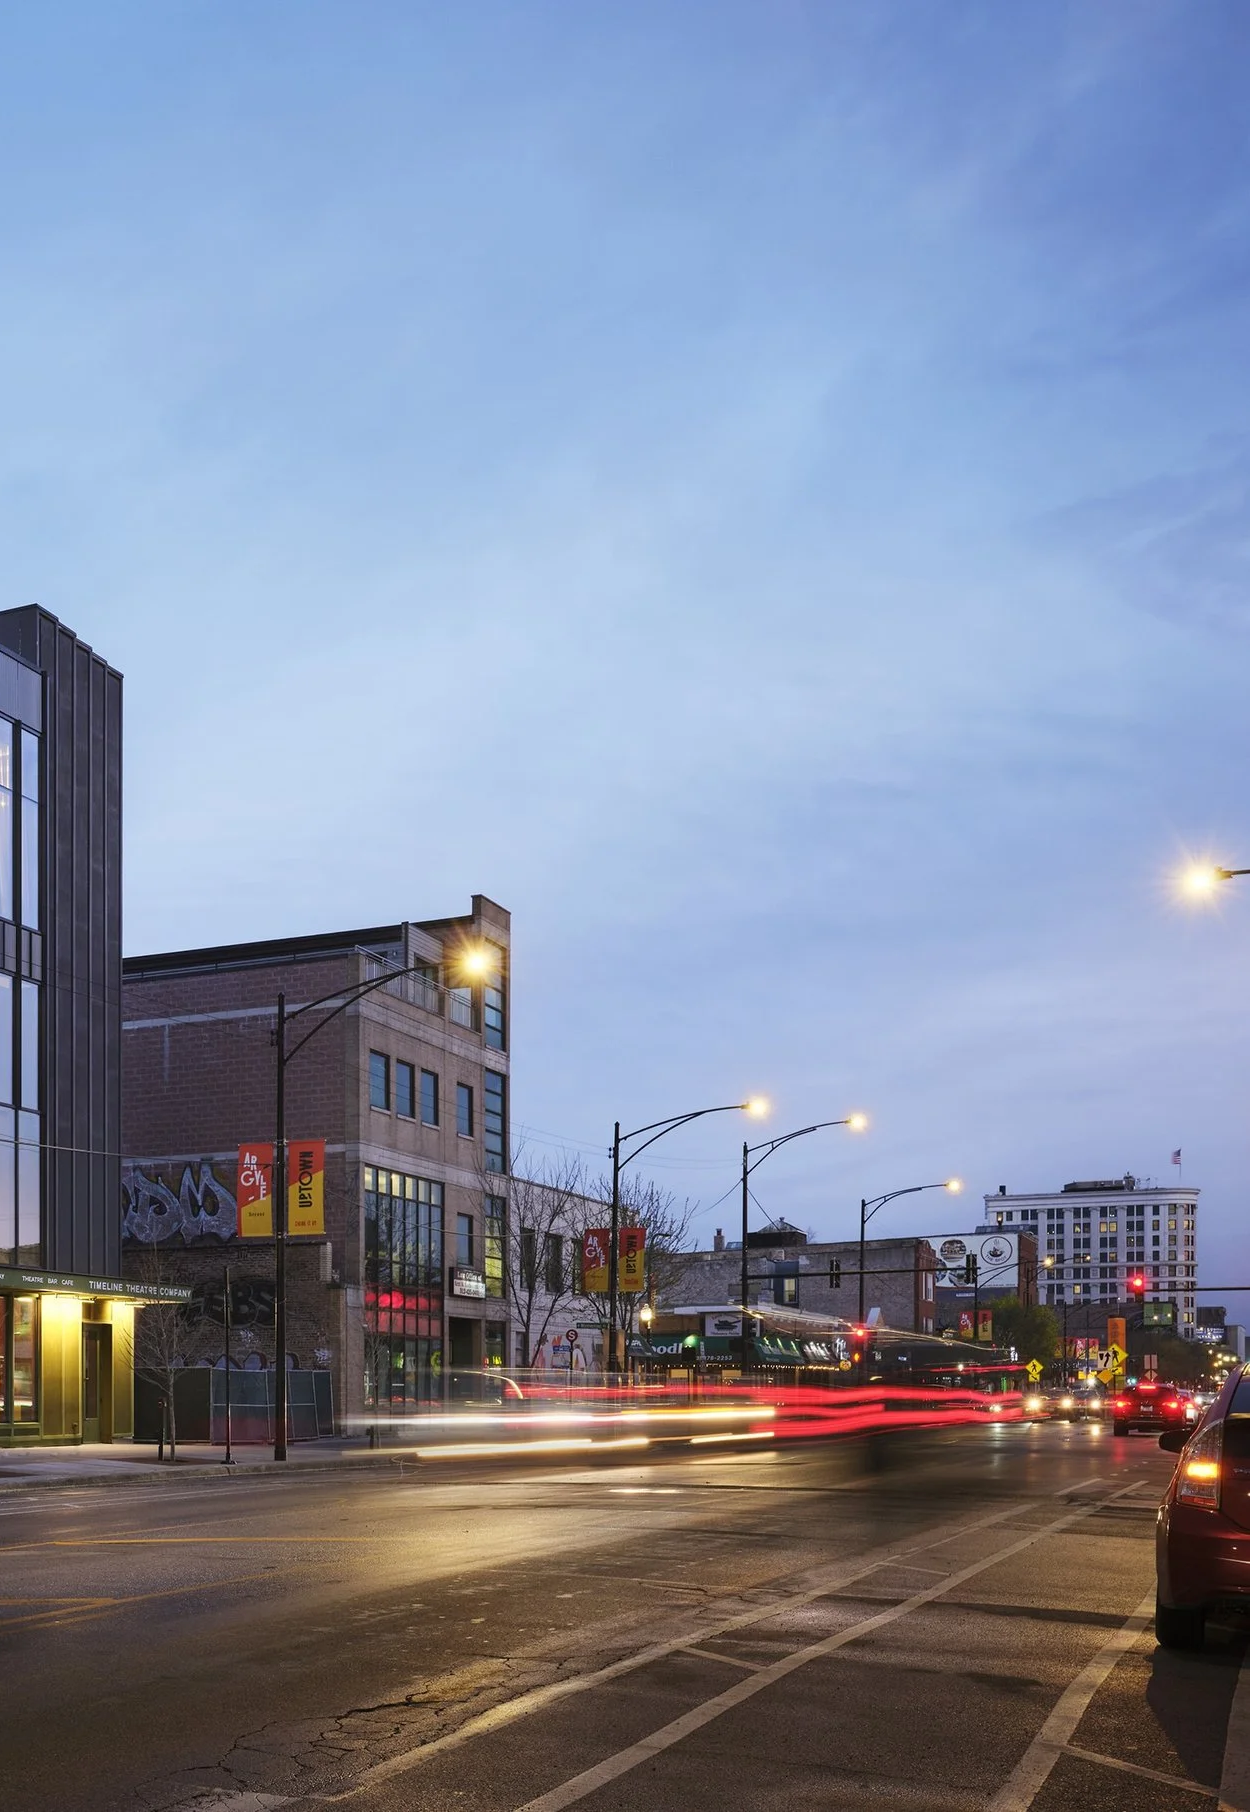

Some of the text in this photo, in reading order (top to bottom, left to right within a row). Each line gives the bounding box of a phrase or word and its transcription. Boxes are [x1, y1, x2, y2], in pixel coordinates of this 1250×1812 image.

[298, 1151, 314, 1209] UPTOWN
[626, 1235, 638, 1274] UPTOWN
[22, 1275, 44, 1284] THEATRE
[89, 1280, 192, 1298] TIMELINE THEATRE COMPANY
